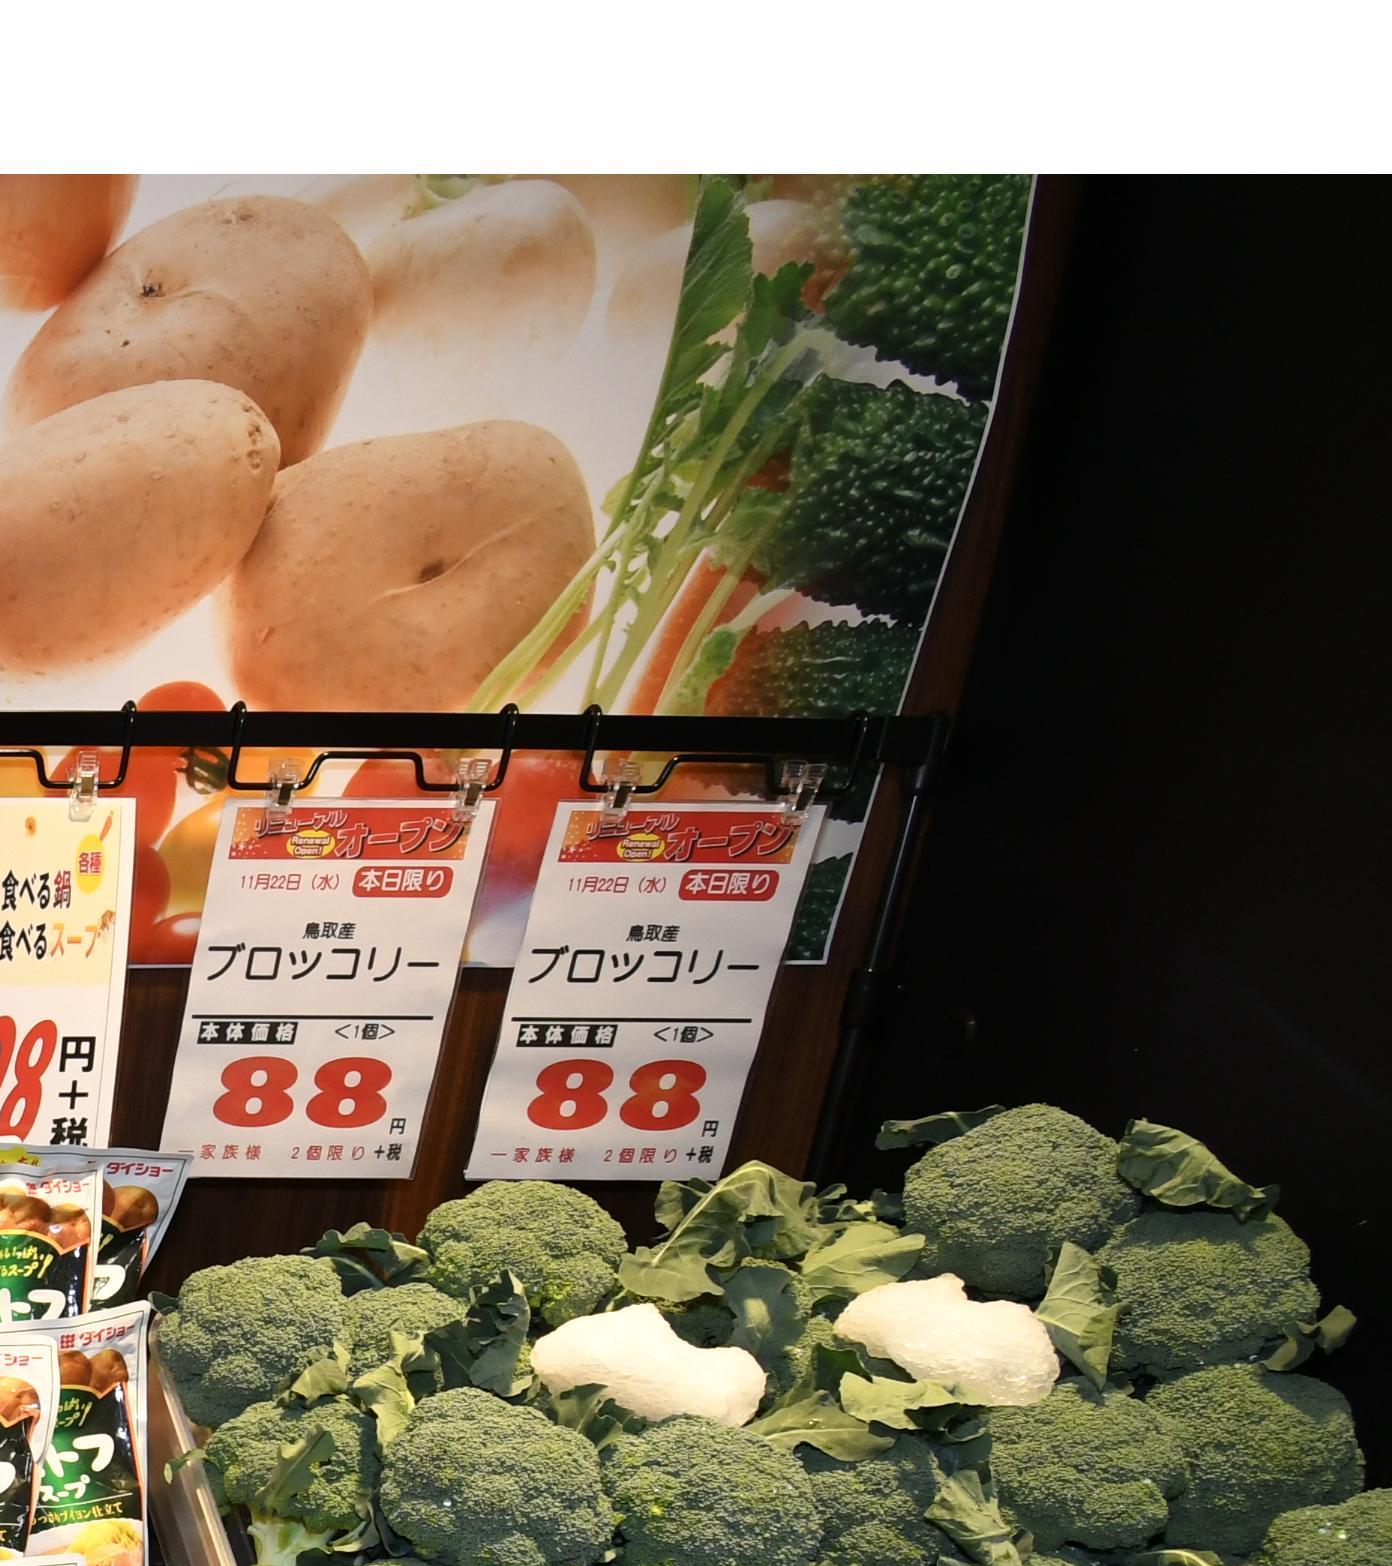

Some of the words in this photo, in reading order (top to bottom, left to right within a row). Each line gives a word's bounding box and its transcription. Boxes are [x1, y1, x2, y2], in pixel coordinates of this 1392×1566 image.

[291, 835, 330, 846] Renewal
[334, 818, 464, 859] オープン
[621, 838, 660, 849] Renewal
[663, 822, 795, 861] オープン
[78, 852, 102, 875] 各種
[240, 873, 301, 891] 11月22日
[358, 869, 445, 893] 本日限り
[568, 876, 629, 893] 11月22日
[685, 872, 771, 896] 本日限り
[302, 922, 356, 940] 鳥取産
[625, 925, 680, 943] 鳥取産
[207, 942, 440, 982] ブロッコリー
[528, 945, 760, 985] ブロッコリー
[200, 1022, 295, 1042] 本体価格
[519, 1025, 616, 1045] 本体価格
[212, 1056, 392, 1128] 88
[526, 1058, 707, 1131] 88
[389, 1118, 406, 1135] 円
[701, 1120, 719, 1137] 円
[290, 1145, 365, 1161] 2個限り
[604, 1147, 677, 1164] 2個限り
[106, 1161, 174, 1178] ダイショー
[42, 1180, 91, 1193] ダイショー
[80, 1324, 135, 1347] ダイショー
[40, 1433, 115, 1479] トフ
